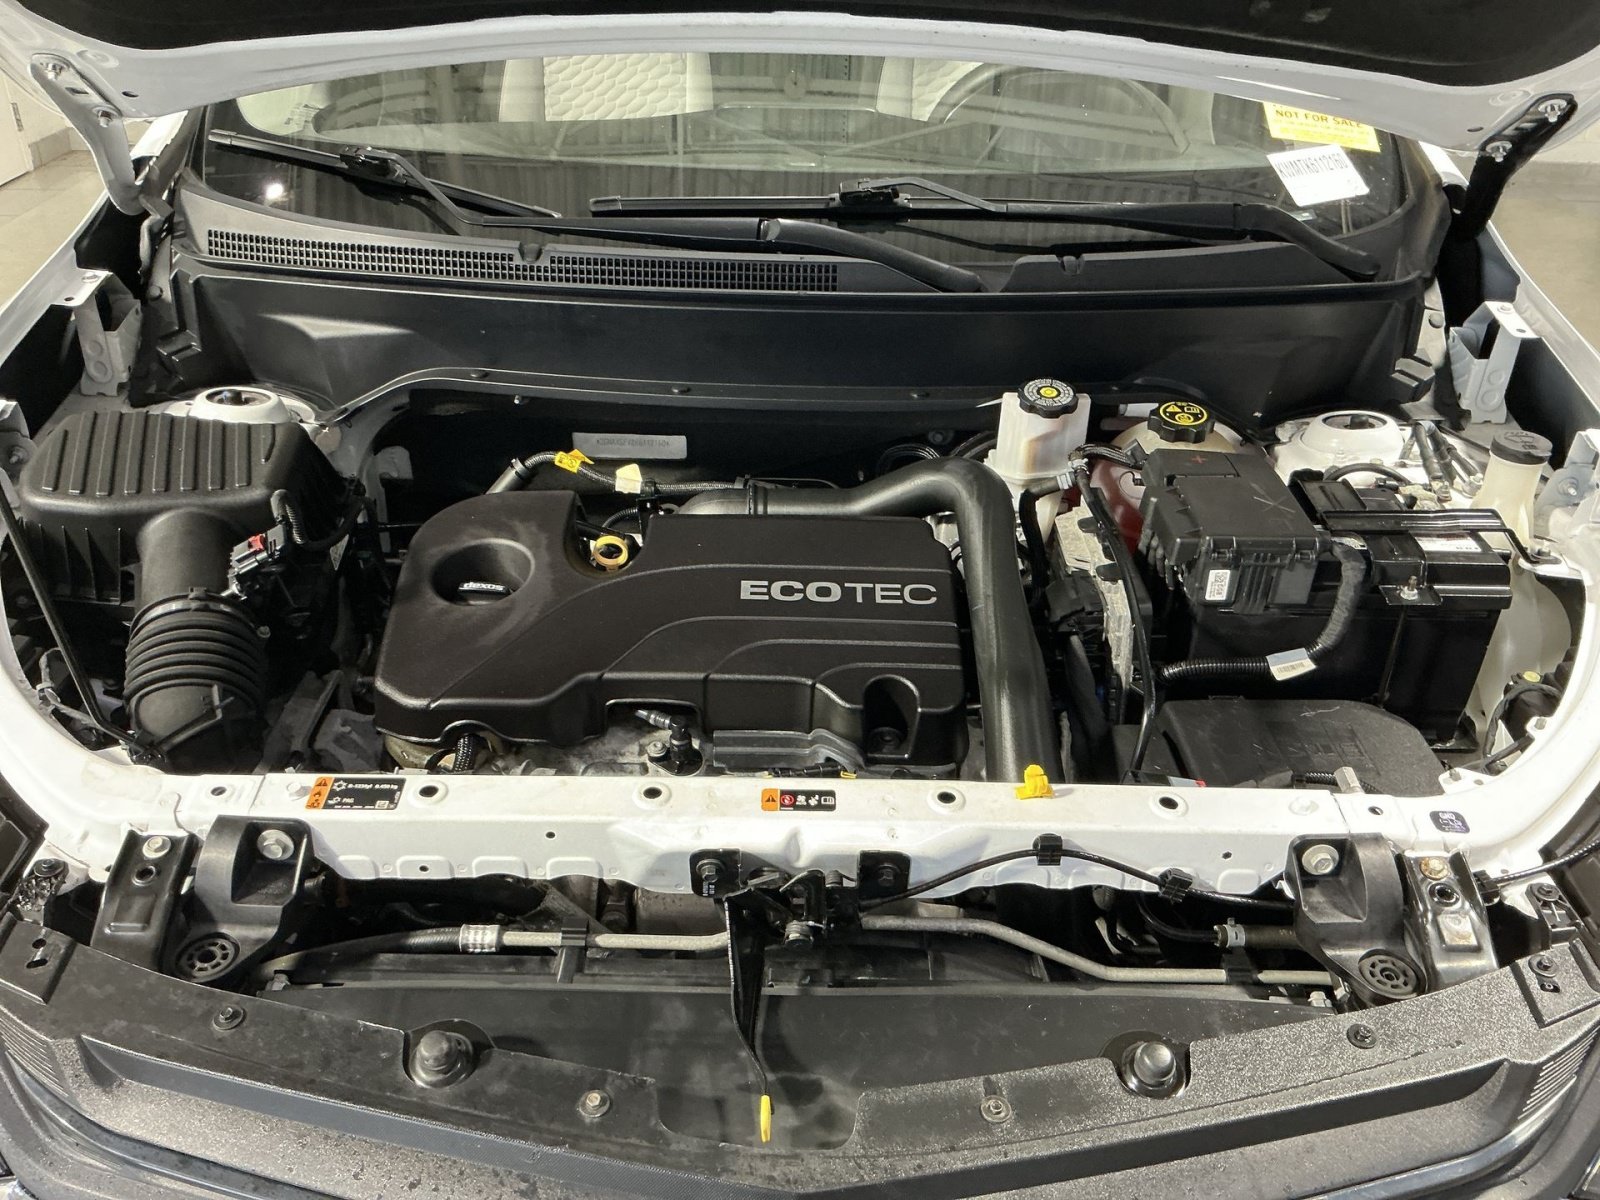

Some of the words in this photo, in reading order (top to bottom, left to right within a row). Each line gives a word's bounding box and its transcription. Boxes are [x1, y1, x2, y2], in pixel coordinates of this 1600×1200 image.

[1275, 109, 1299, 119] NOT
[1304, 113, 1329, 123] FOR
[1332, 117, 1364, 129] SALE
[463, 582, 505, 591] dexos
[740, 580, 938, 605] ECOTEC
